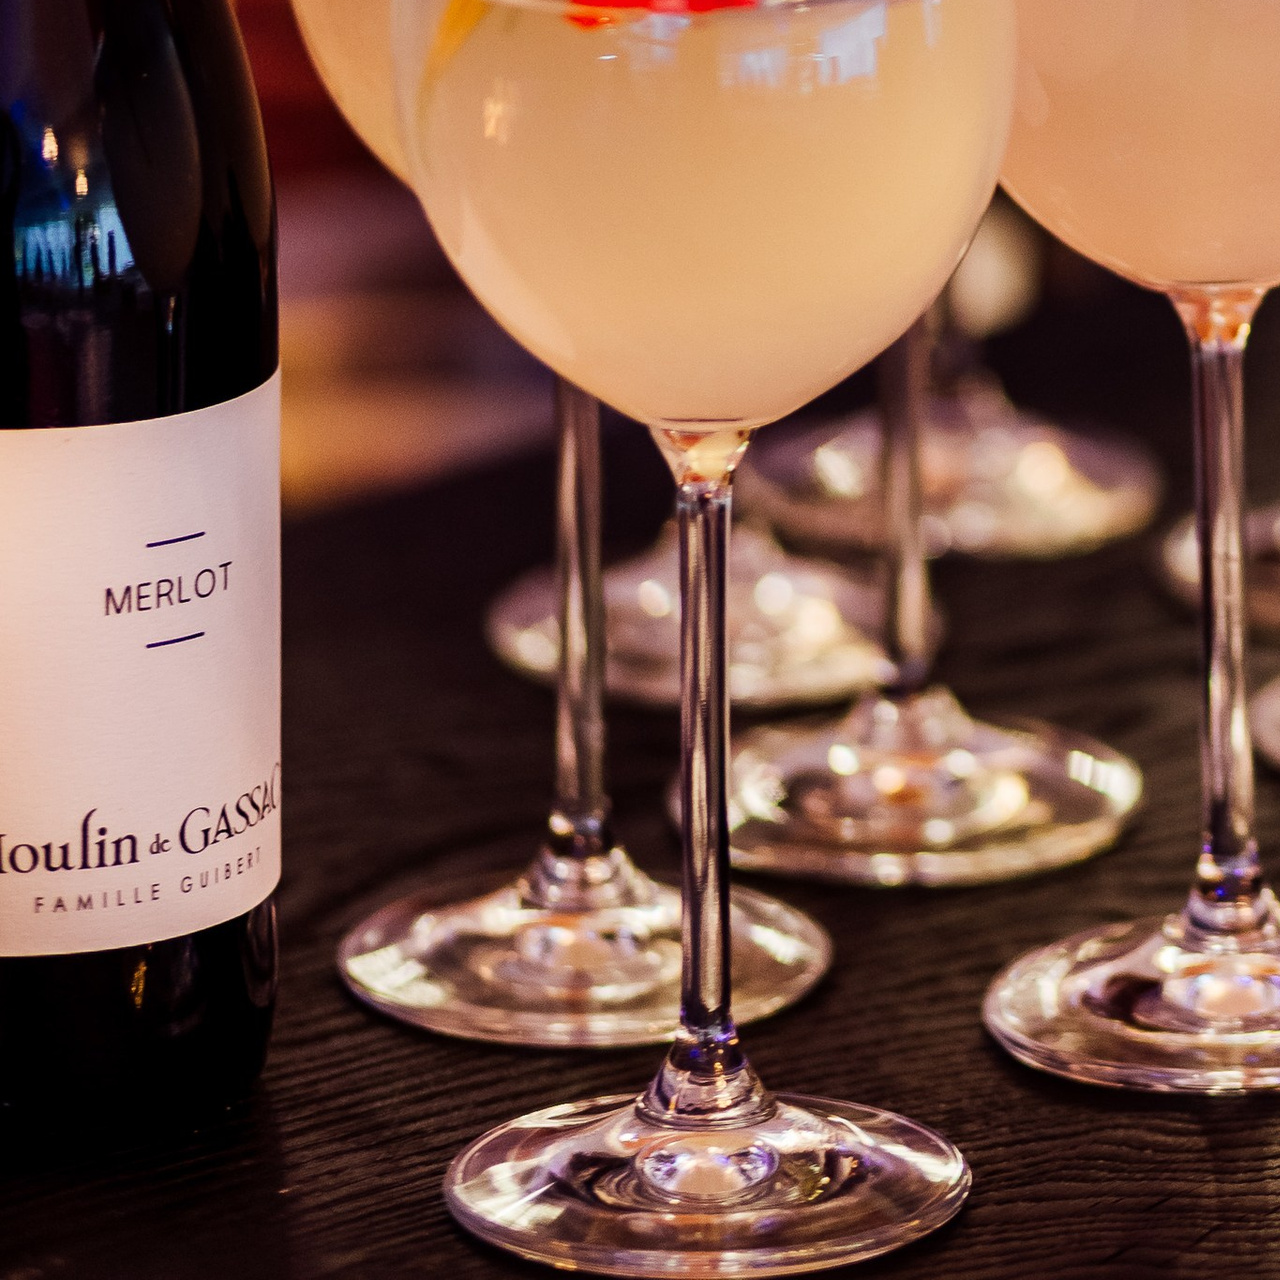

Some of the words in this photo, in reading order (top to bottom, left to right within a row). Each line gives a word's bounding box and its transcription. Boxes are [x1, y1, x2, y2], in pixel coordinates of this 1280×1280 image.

[104, 561, 233, 616] MERLOT
[149, 833, 171, 856] de
[34, 883, 161, 914] FAMILLE
[180, 846, 262, 894] GUIBERT
